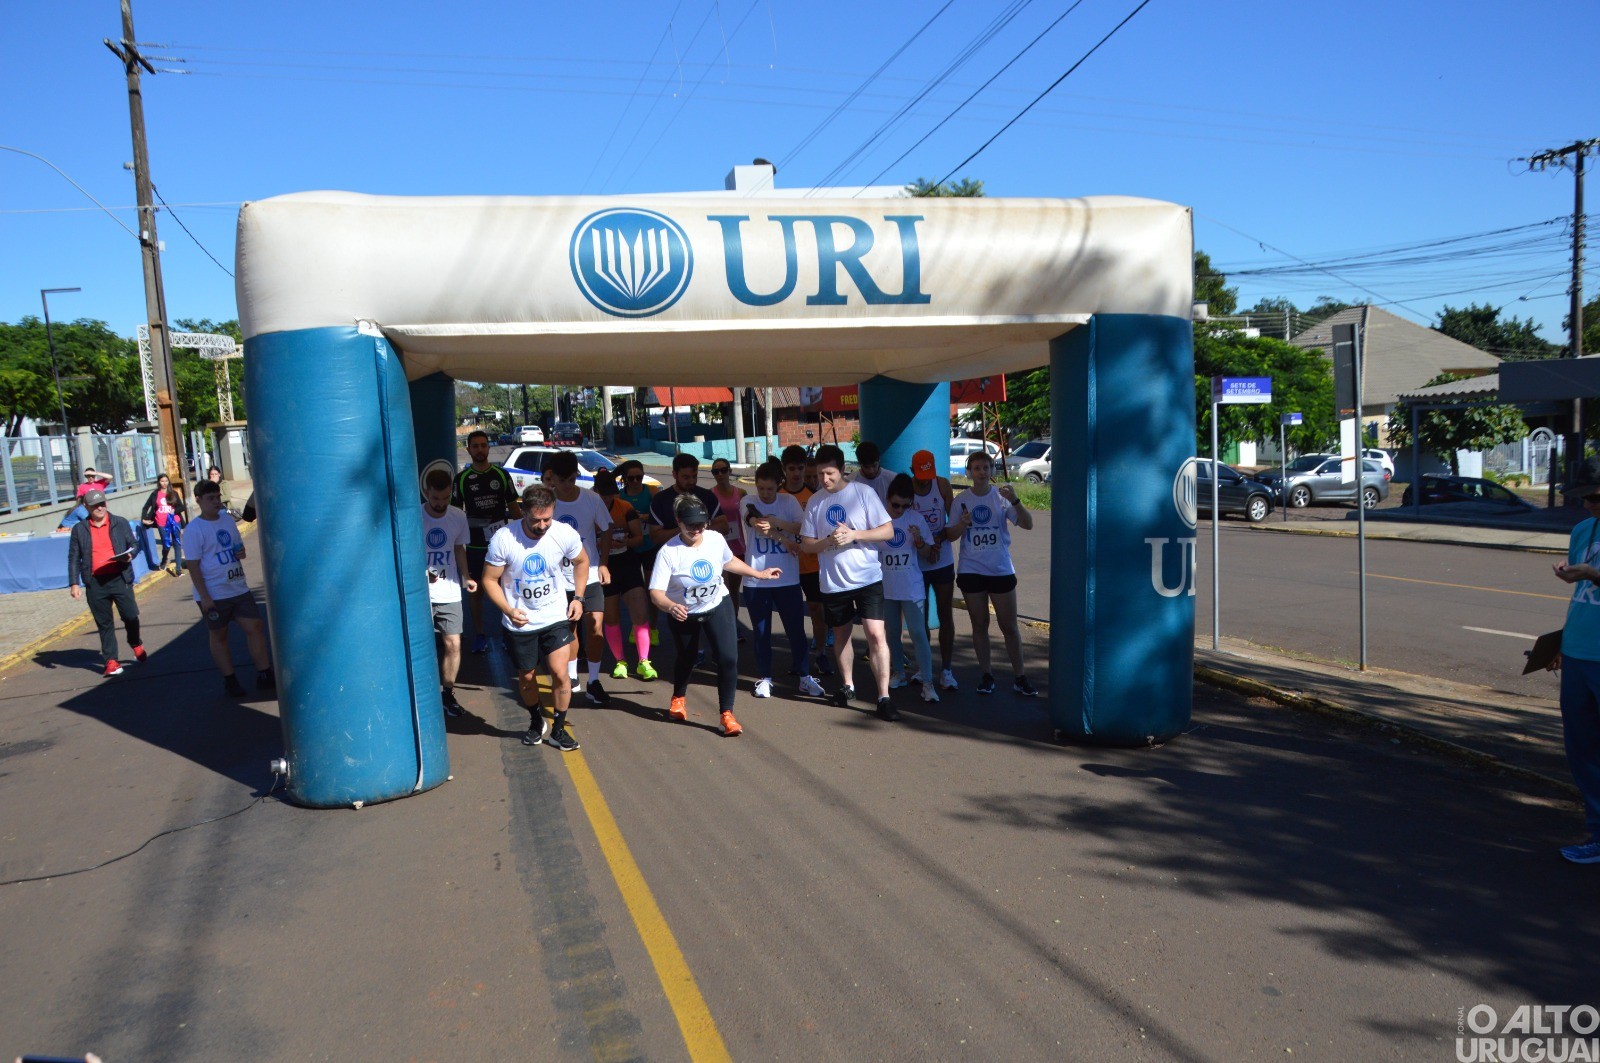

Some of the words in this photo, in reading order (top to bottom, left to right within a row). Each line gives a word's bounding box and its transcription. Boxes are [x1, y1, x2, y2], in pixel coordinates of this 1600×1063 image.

[706, 214, 931, 307] URI
[973, 533, 997, 547] 049
[885, 553, 910, 567] 017
[523, 584, 551, 600] 068
[690, 584, 717, 598] 127
